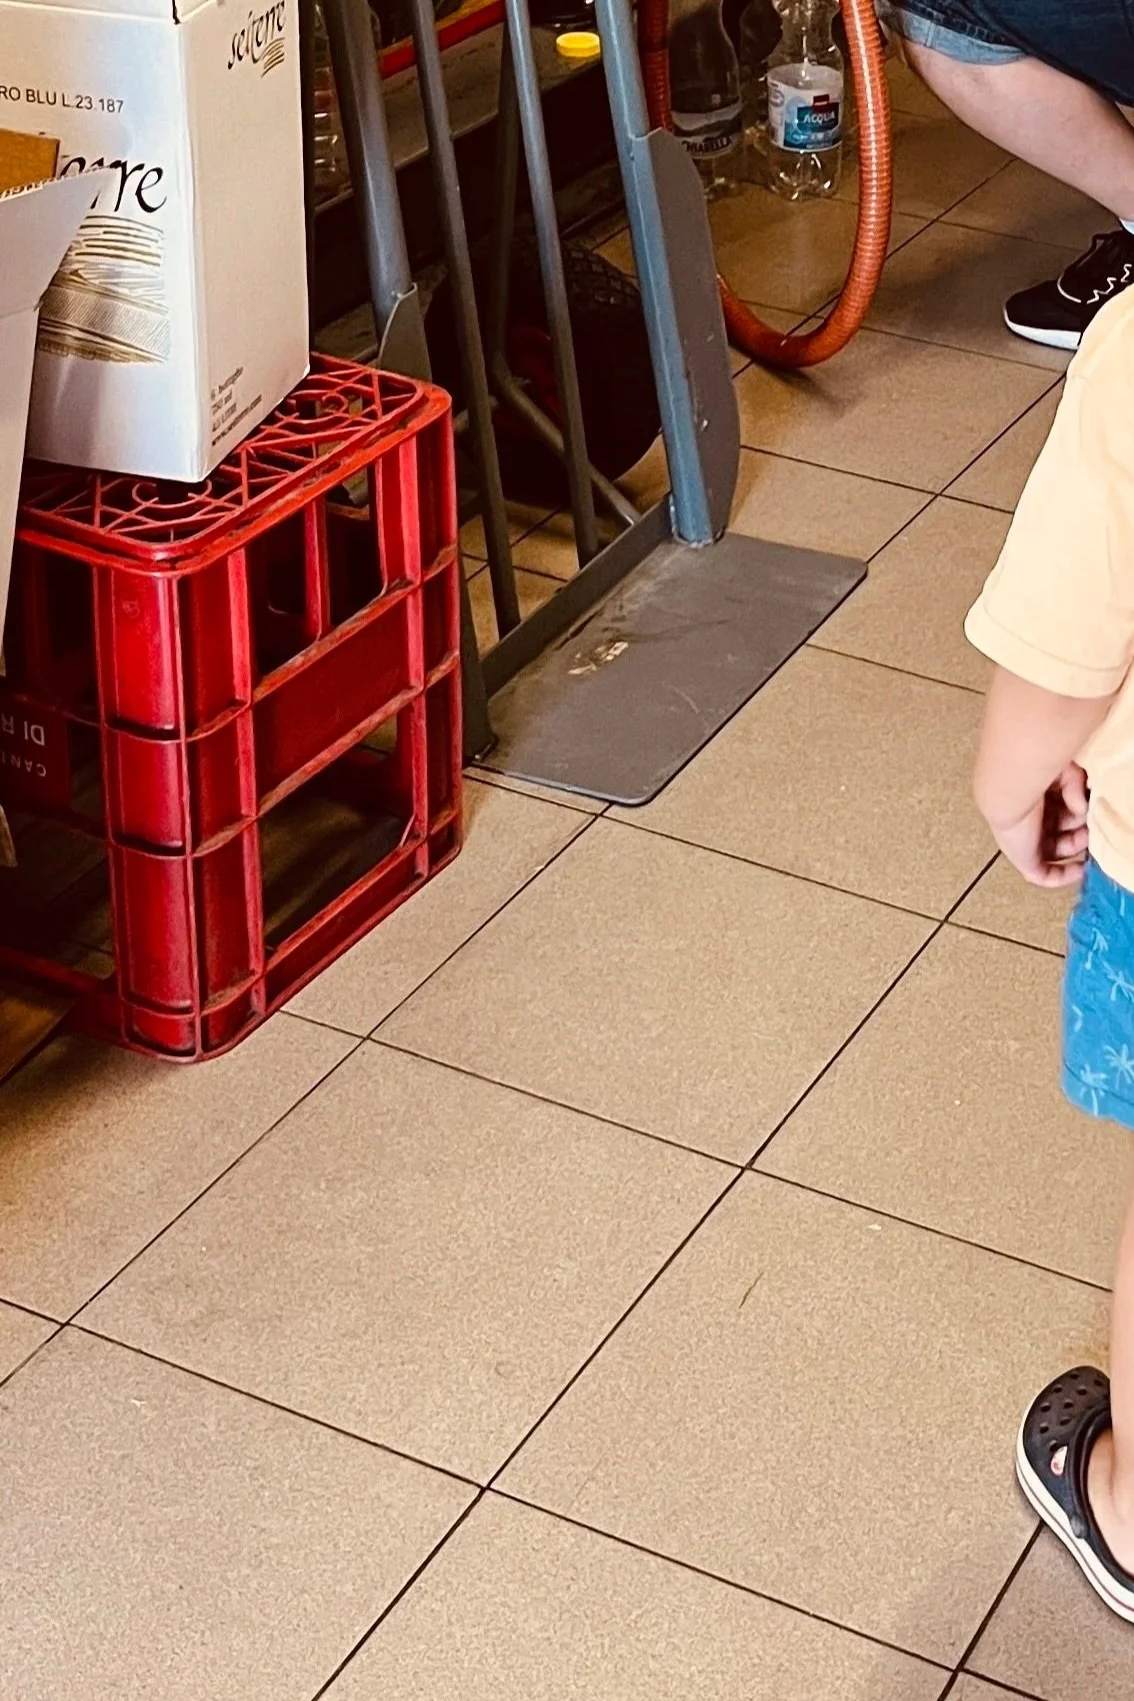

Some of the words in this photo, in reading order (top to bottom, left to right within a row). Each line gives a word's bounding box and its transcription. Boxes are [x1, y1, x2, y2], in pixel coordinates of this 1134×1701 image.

[227, 0, 286, 71] seiterre
[25, 88, 57, 106] BLU
[803, 110, 836, 126] ACQUA
